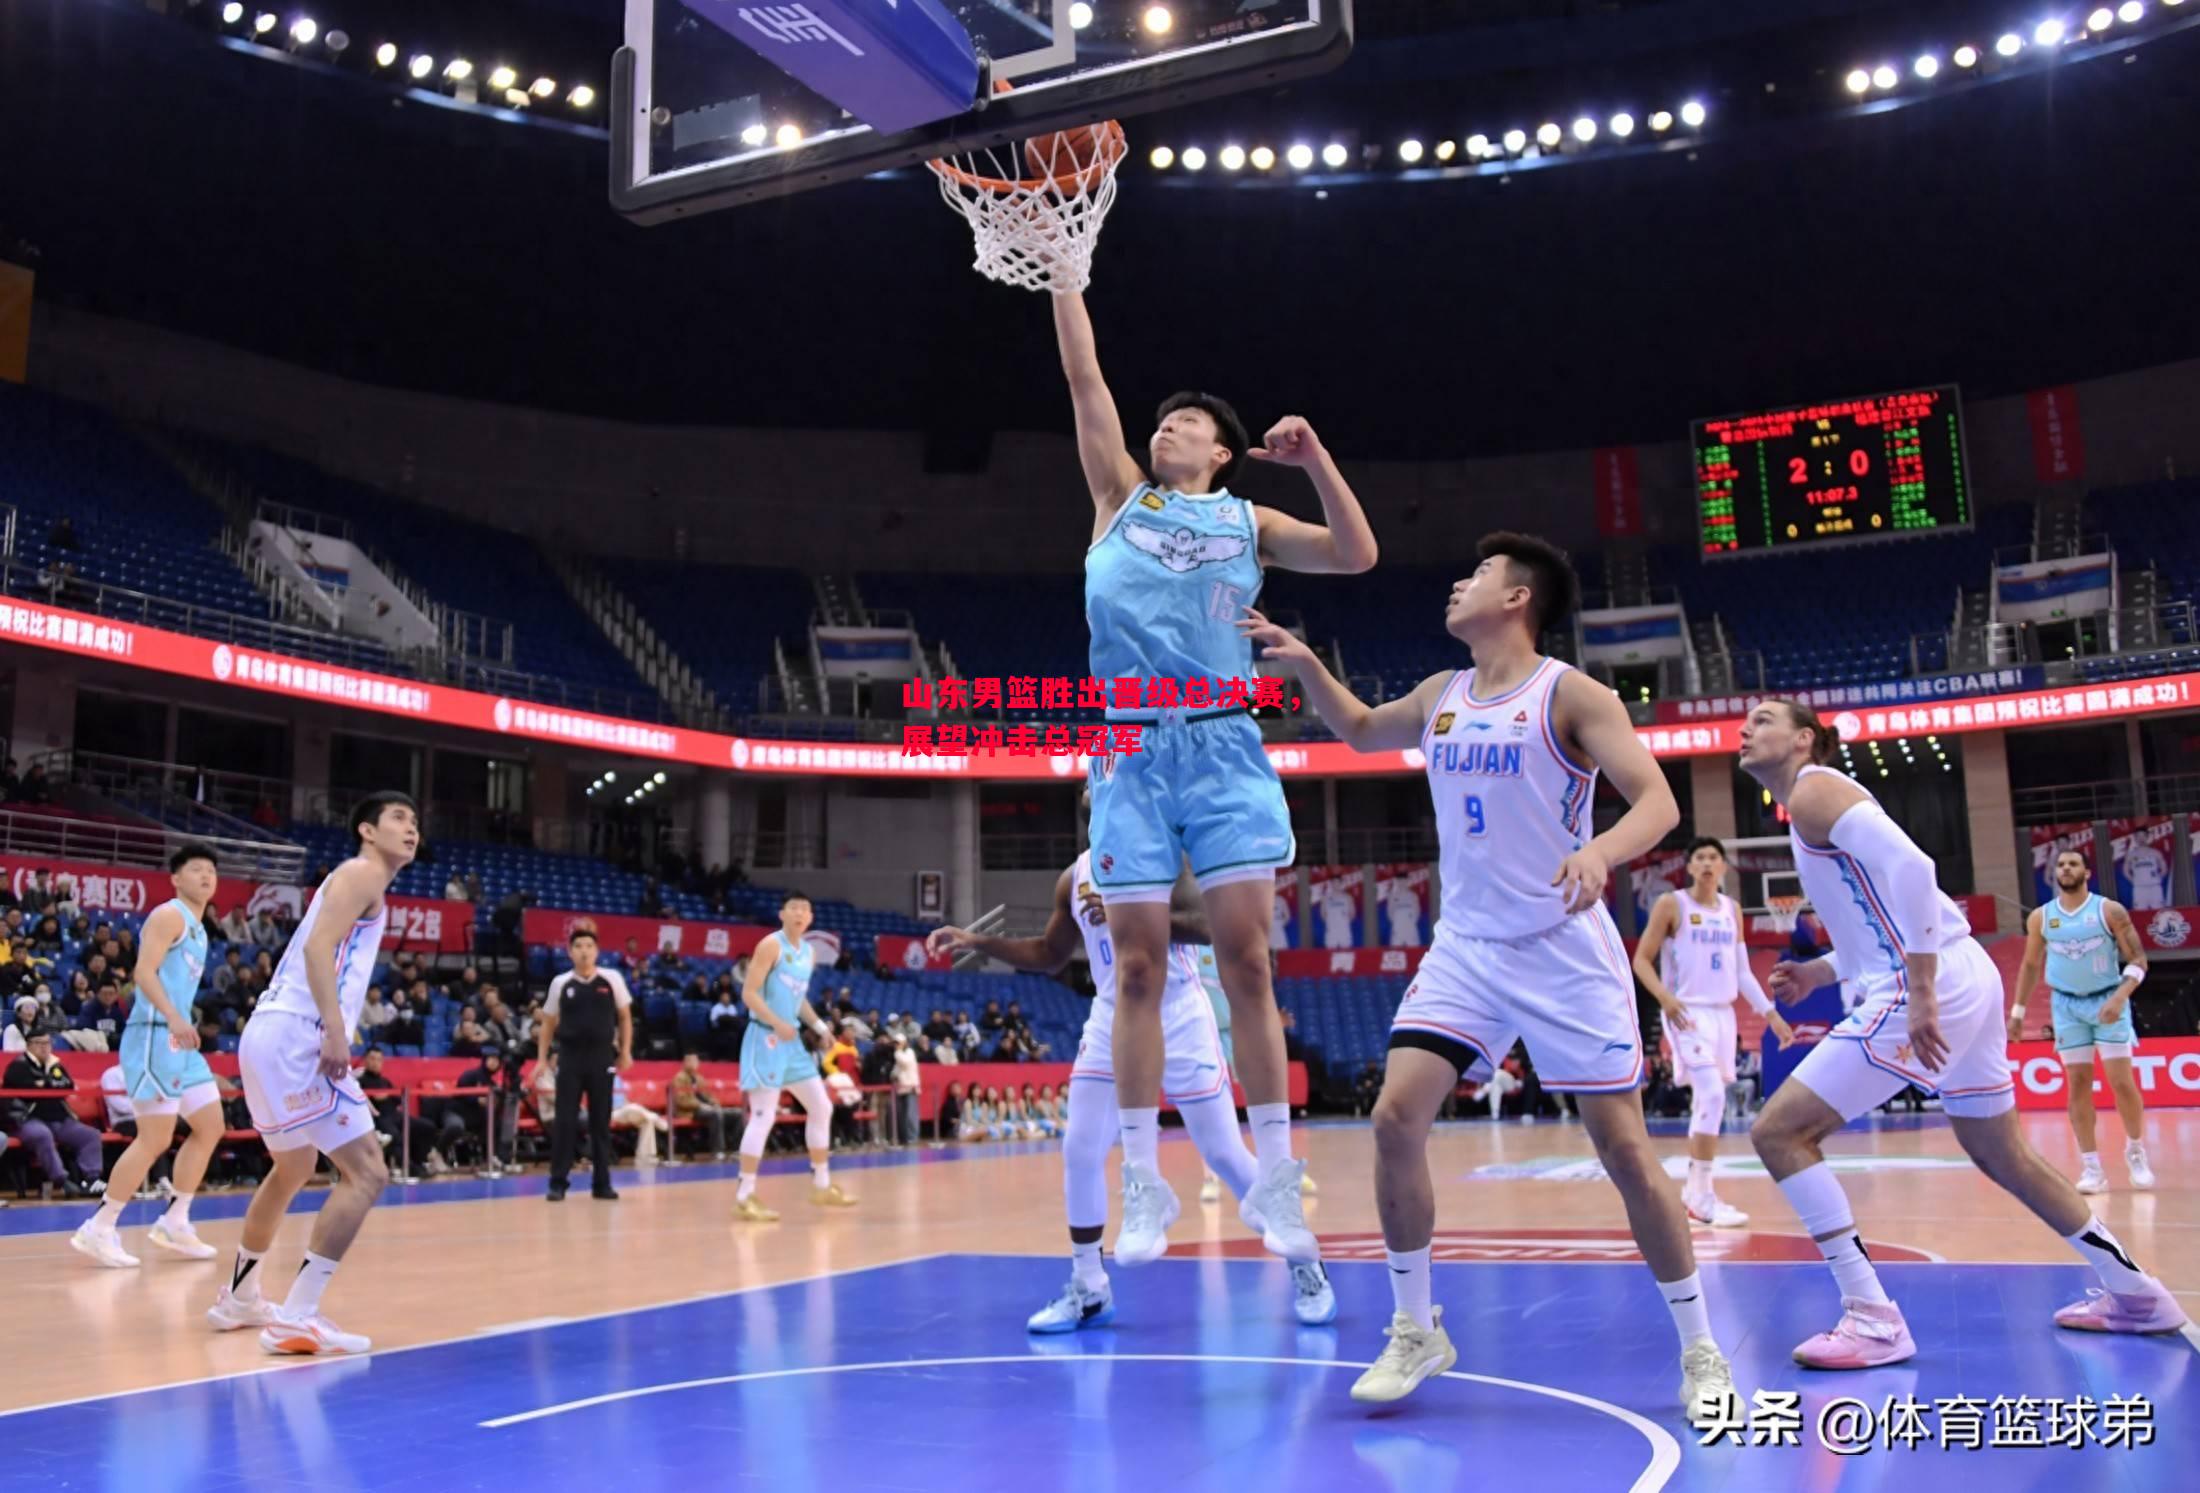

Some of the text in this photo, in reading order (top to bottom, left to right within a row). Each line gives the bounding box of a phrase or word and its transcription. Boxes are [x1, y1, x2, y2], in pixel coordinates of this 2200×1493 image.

[1789, 457, 1808, 484] 2
[1849, 449, 1870, 477] 0
[1806, 485, 1858, 505] 11:07.3
[1432, 742, 1525, 778] FUJIAN
[1464, 793, 1488, 838] 9
[1711, 952, 1722, 970] 6
